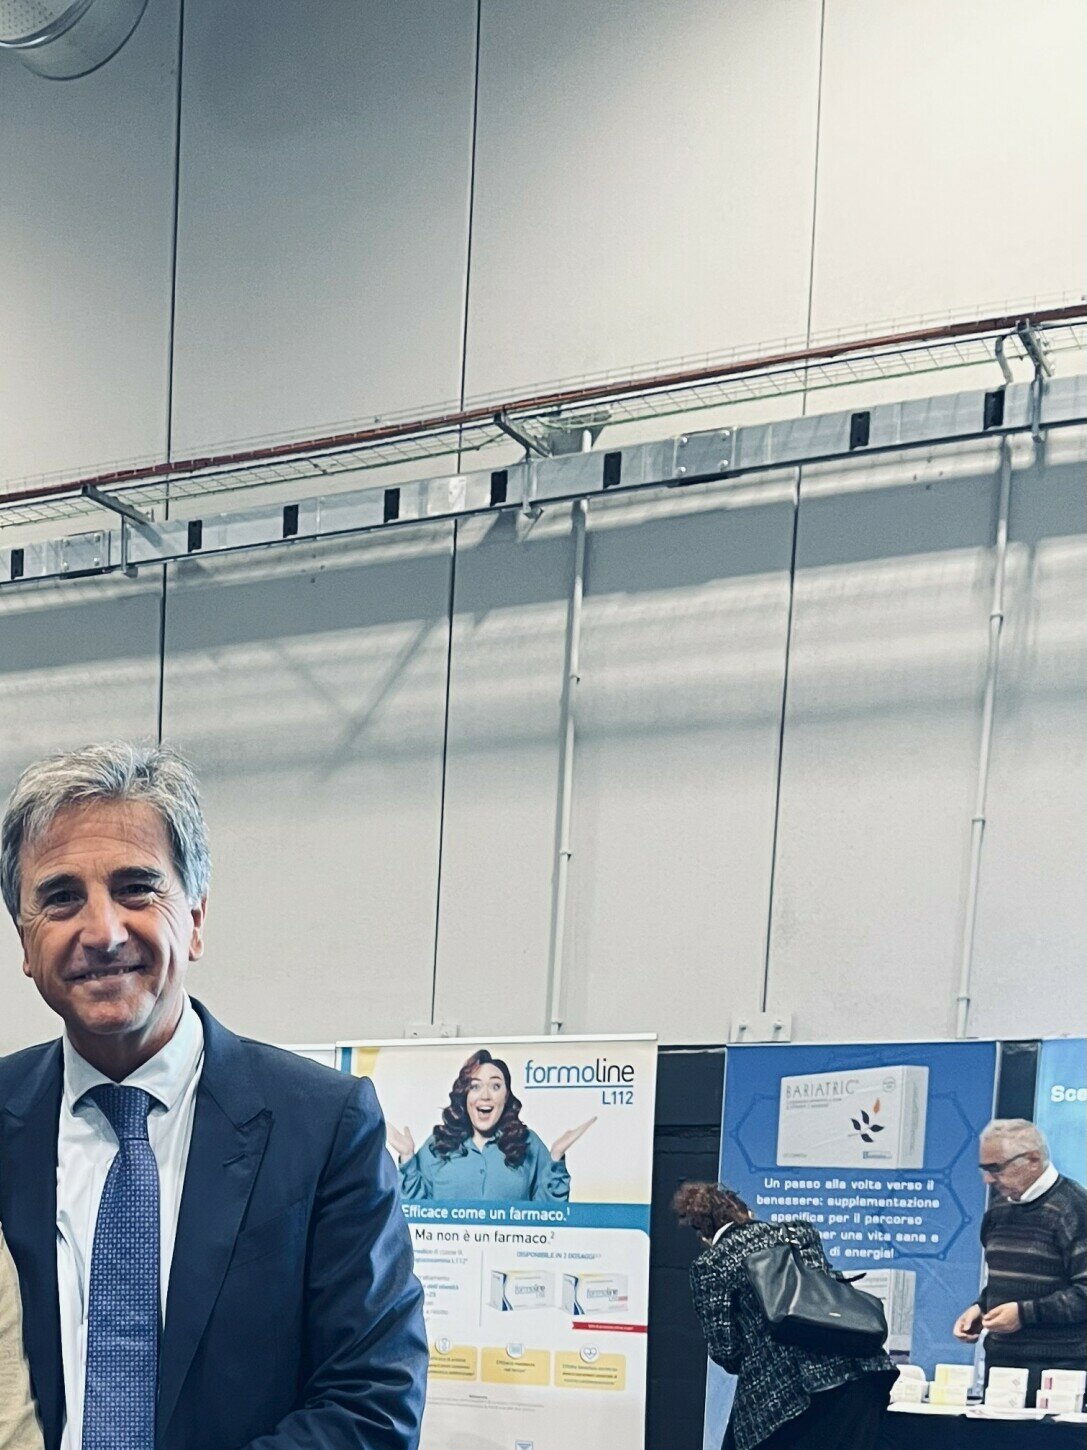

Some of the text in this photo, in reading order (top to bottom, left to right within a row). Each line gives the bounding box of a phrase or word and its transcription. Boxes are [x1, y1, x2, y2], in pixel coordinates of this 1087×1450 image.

[525, 1058, 634, 1083] formoline
[602, 1090, 634, 1105] L112
[764, 1177, 780, 1189] Un
[784, 1180, 821, 1191] passo
[825, 1178, 846, 1190] alla
[886, 1181, 923, 1191] verso
[926, 1179, 935, 1191] il
[756, 1194, 940, 1209] benessere: supplementazione
[402, 1204, 449, 1219] Efficace
[451, 1208, 486, 1219] come
[489, 1208, 506, 1220] un
[828, 1214, 850, 1225] per
[853, 1212, 861, 1223] il
[864, 1214, 923, 1226] percorso
[415, 1228, 433, 1241] Ma
[437, 1231, 459, 1241] non
[463, 1229, 471, 1242] è
[474, 1233, 490, 1243] un
[840, 1231, 863, 1241] una
[867, 1230, 892, 1242] vita
[895, 1233, 927, 1243] sana
[930, 1233, 939, 1243] e
[829, 1246, 841, 1257] di
